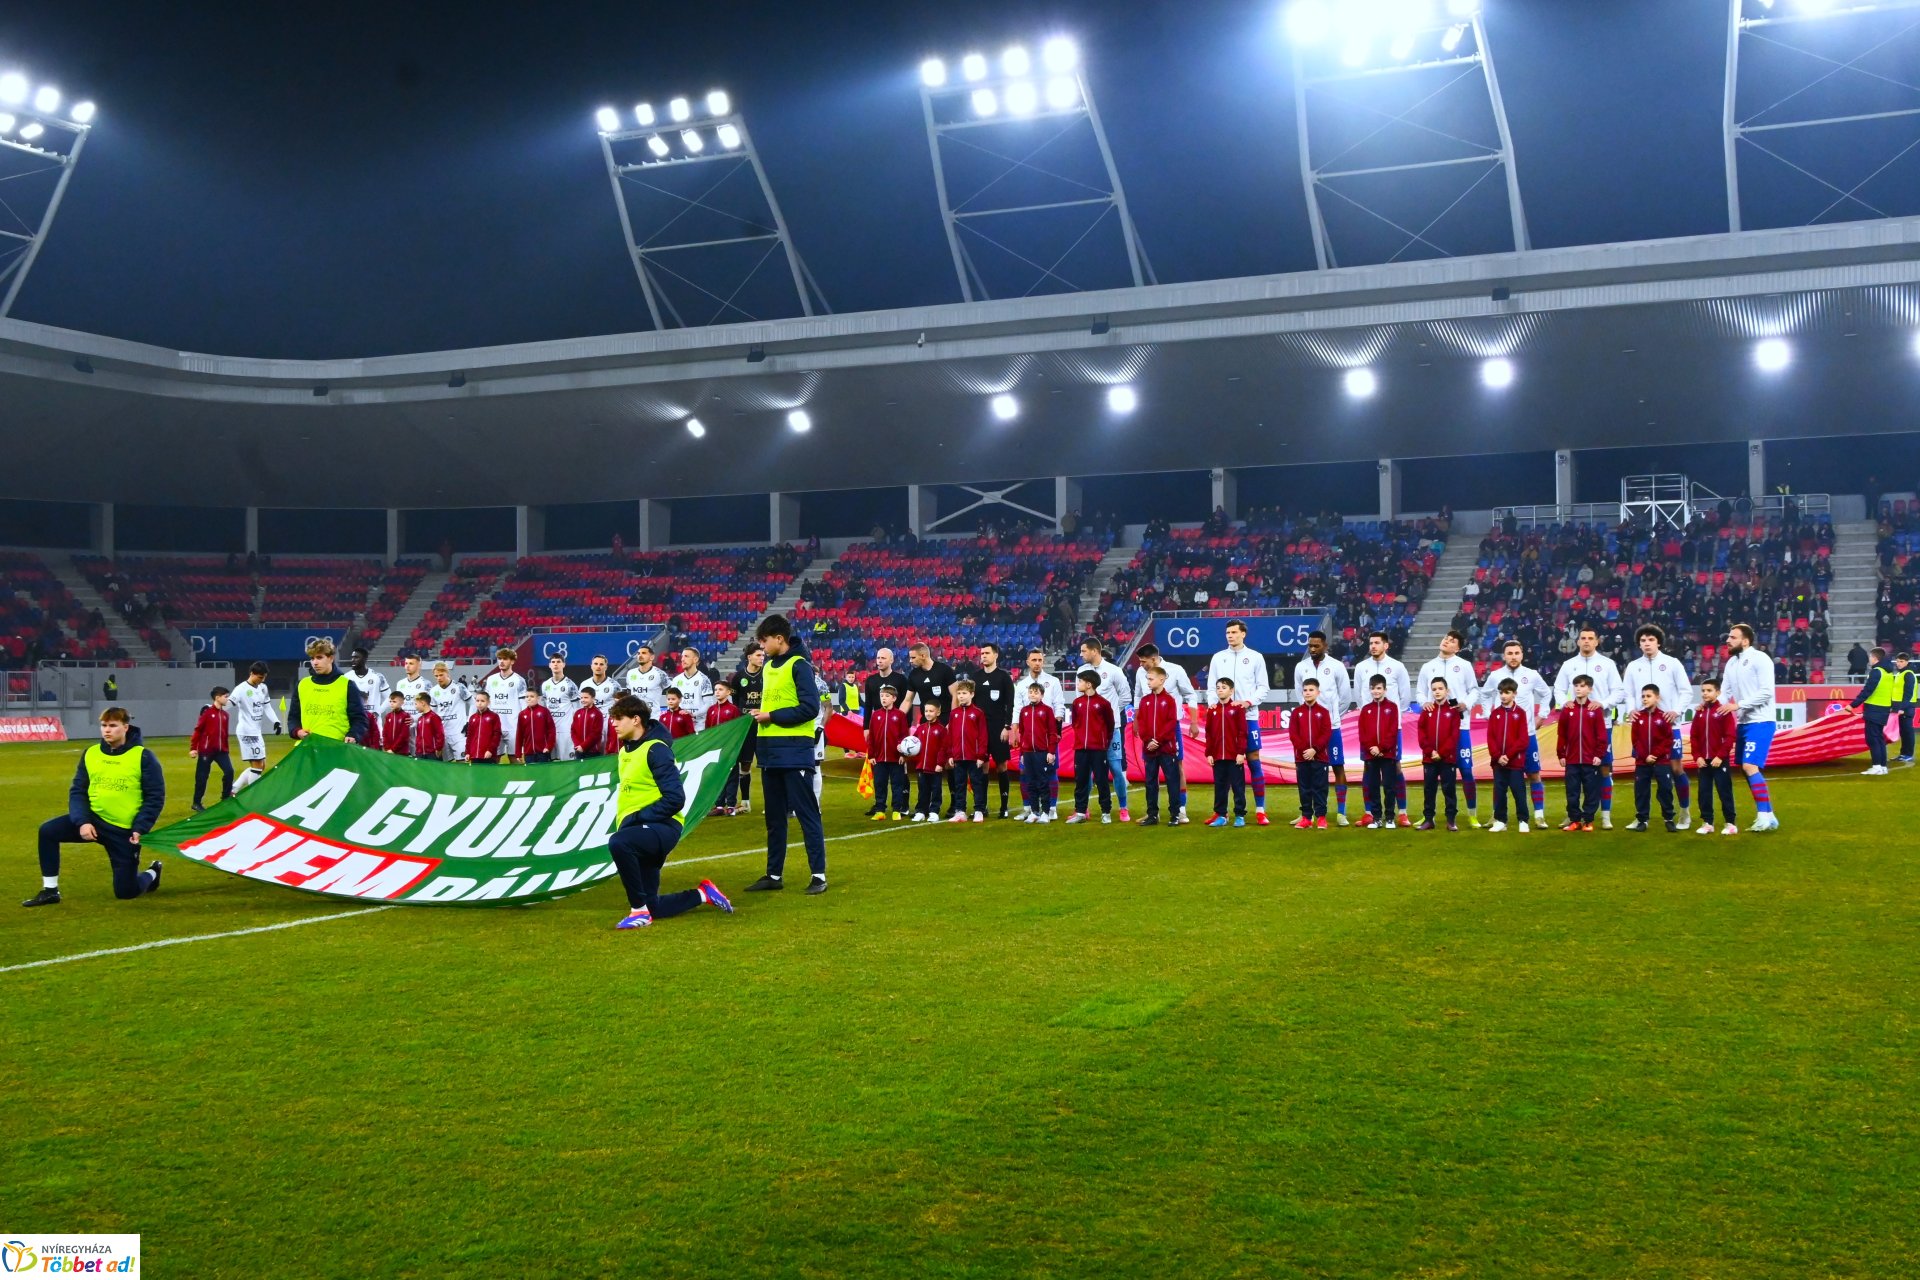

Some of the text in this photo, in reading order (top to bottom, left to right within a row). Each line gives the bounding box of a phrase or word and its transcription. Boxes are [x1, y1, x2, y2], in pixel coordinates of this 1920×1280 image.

[1167, 627, 1200, 648] C6
[1276, 624, 1310, 646] C5
[190, 635, 217, 654] D1
[543, 641, 568, 660] C8
[0, 723, 58, 734] AGYAR KUPA
[1251, 730, 1259, 740] 15
[251, 747, 261, 755] 10
[1332, 746, 1339, 756] 8
[1460, 748, 1471, 758] 66
[268, 749, 722, 858] A GYŰLÖLT
